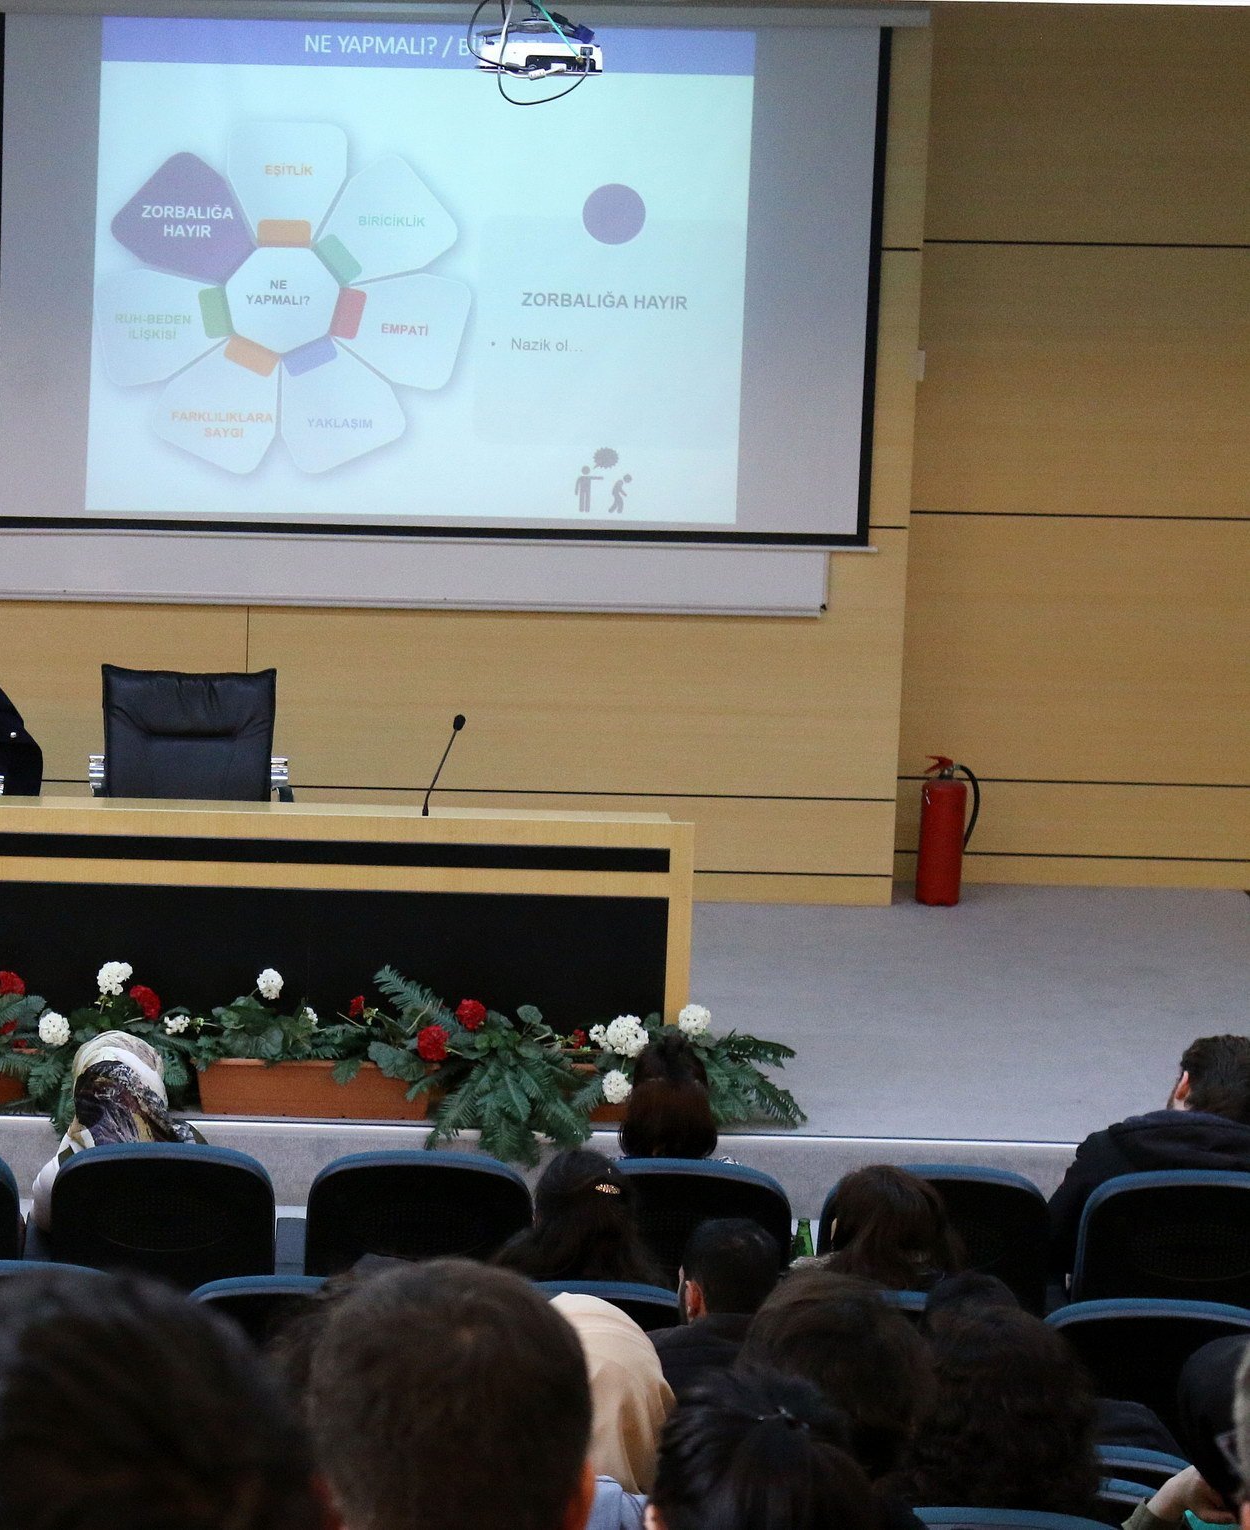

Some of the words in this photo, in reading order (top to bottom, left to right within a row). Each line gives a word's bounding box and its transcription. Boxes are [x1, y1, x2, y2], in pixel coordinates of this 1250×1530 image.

[304, 34, 332, 53] NE
[337, 35, 438, 56] YAPMALI?
[264, 163, 313, 177] EŞİTLİK
[141, 205, 234, 220] ZORBALIĞA
[163, 225, 212, 238] HAYIR
[269, 279, 288, 290] NE
[246, 294, 311, 306] YAPMALI?
[520, 291, 629, 309] ZORBALIĞA
[634, 295, 688, 311] HAYIR
[115, 313, 192, 325] RUH-BEDEN
[381, 323, 429, 337] EMPATİ
[511, 337, 551, 352] Nazik
[171, 411, 274, 424] FARKLILIKLARA
[307, 418, 373, 431] YAKLAŞIM
[204, 427, 244, 439] SAYGI
